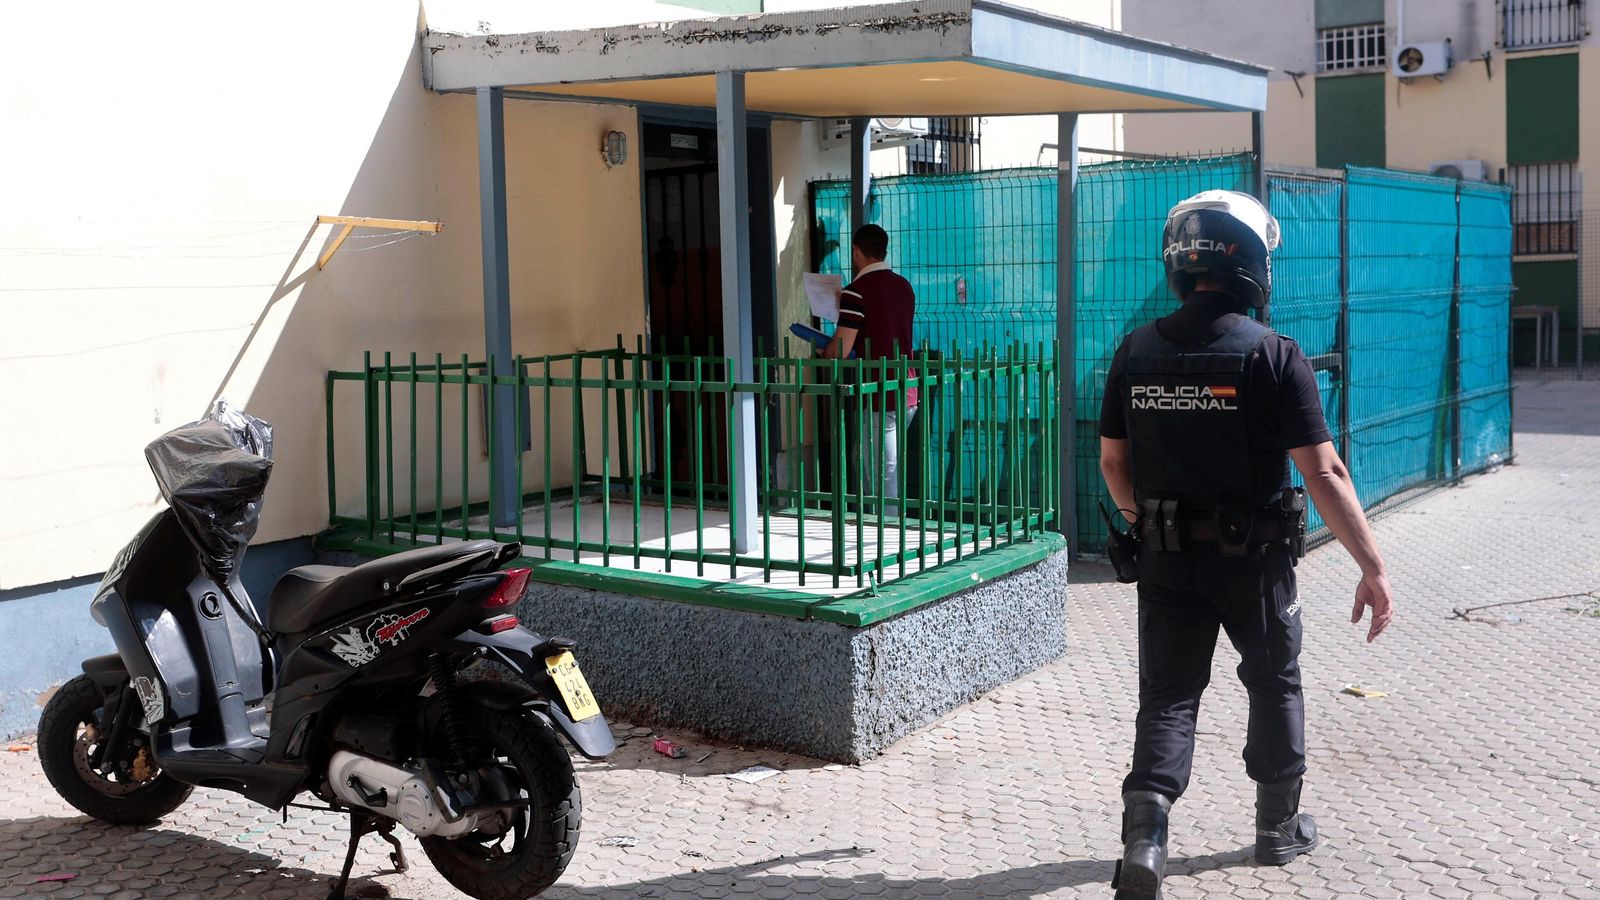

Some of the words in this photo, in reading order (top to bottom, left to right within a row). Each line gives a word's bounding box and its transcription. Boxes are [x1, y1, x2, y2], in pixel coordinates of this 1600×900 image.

[1163, 239, 1226, 262] POLICIA
[1131, 385, 1213, 397] POLICIA
[1131, 398, 1238, 410] NACIONAL
